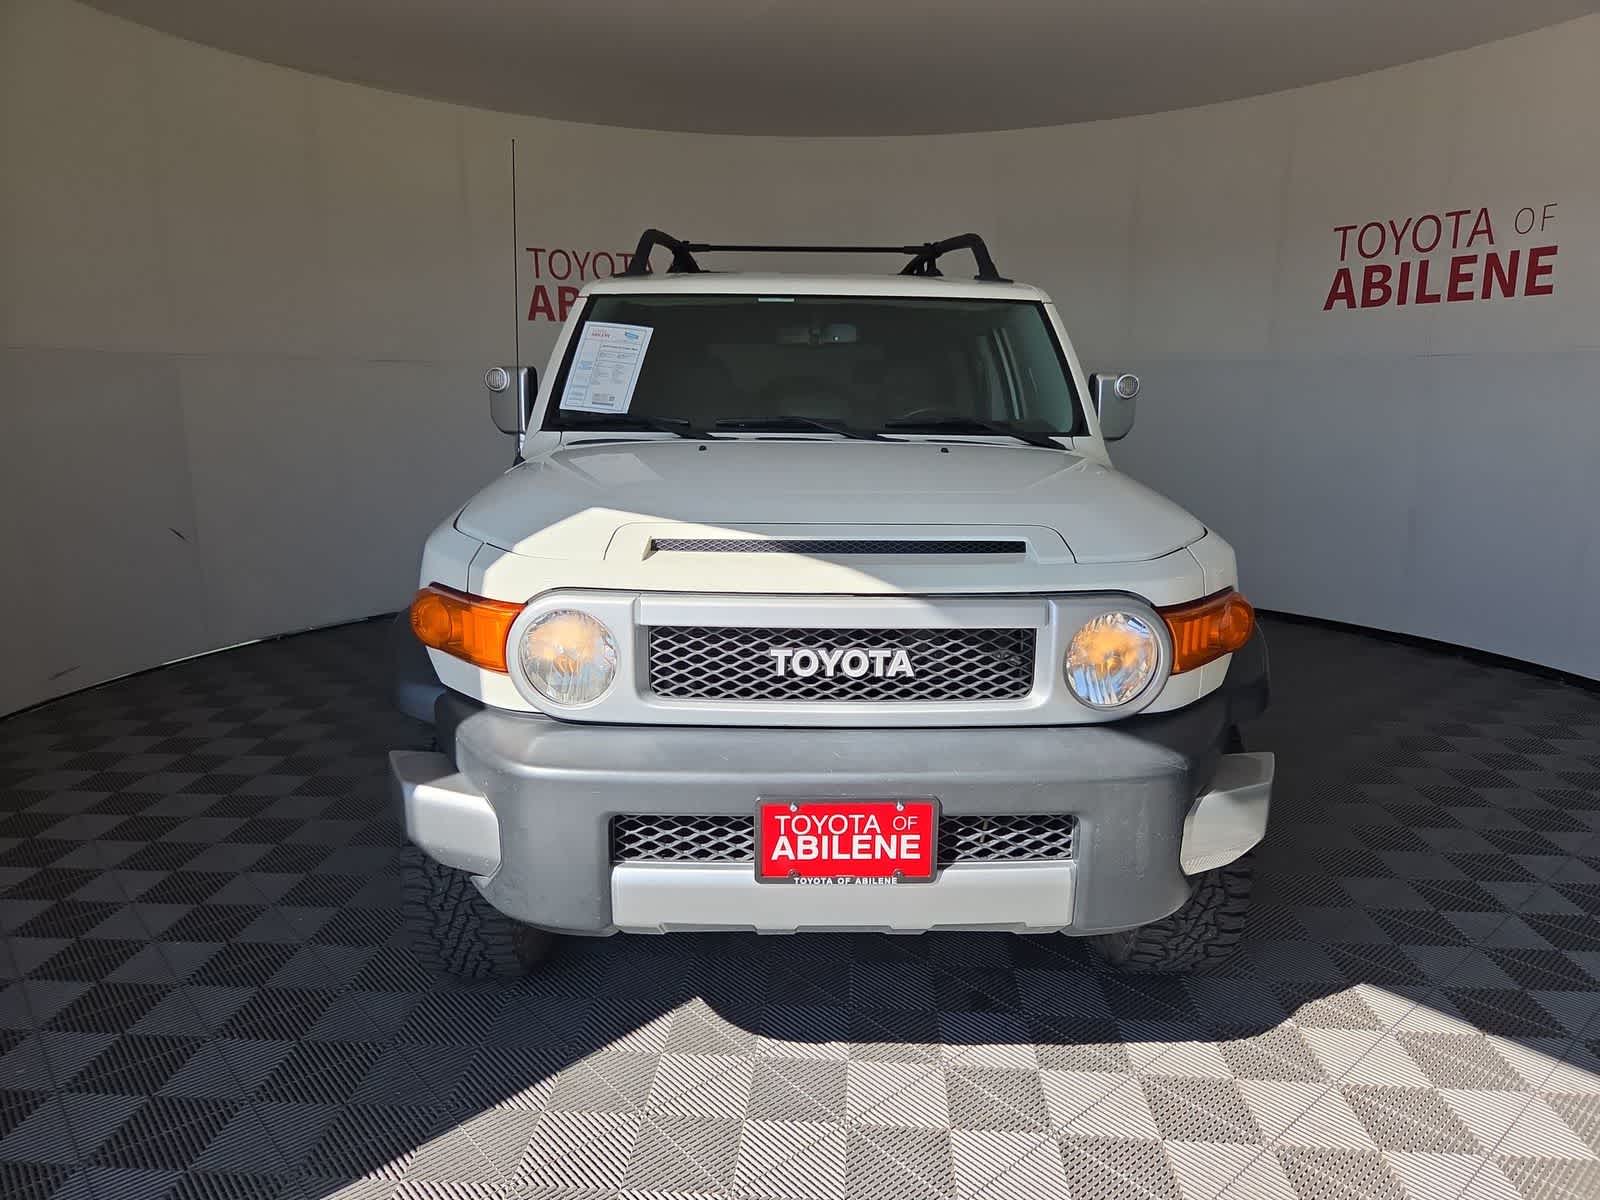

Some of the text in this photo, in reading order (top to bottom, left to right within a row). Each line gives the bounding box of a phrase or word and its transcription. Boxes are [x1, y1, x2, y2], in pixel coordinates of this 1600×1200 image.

[1333, 203, 1558, 261] TOYOTA OF
[526, 247, 651, 281] TOYOT
[1323, 245, 1558, 311] ABILENE
[769, 648, 915, 678] TOYOTA
[775, 814, 918, 835] TOYOTA OF
[771, 834, 921, 861] ABILENE
[793, 877, 897, 885] TOYOTA OF ABILENE
